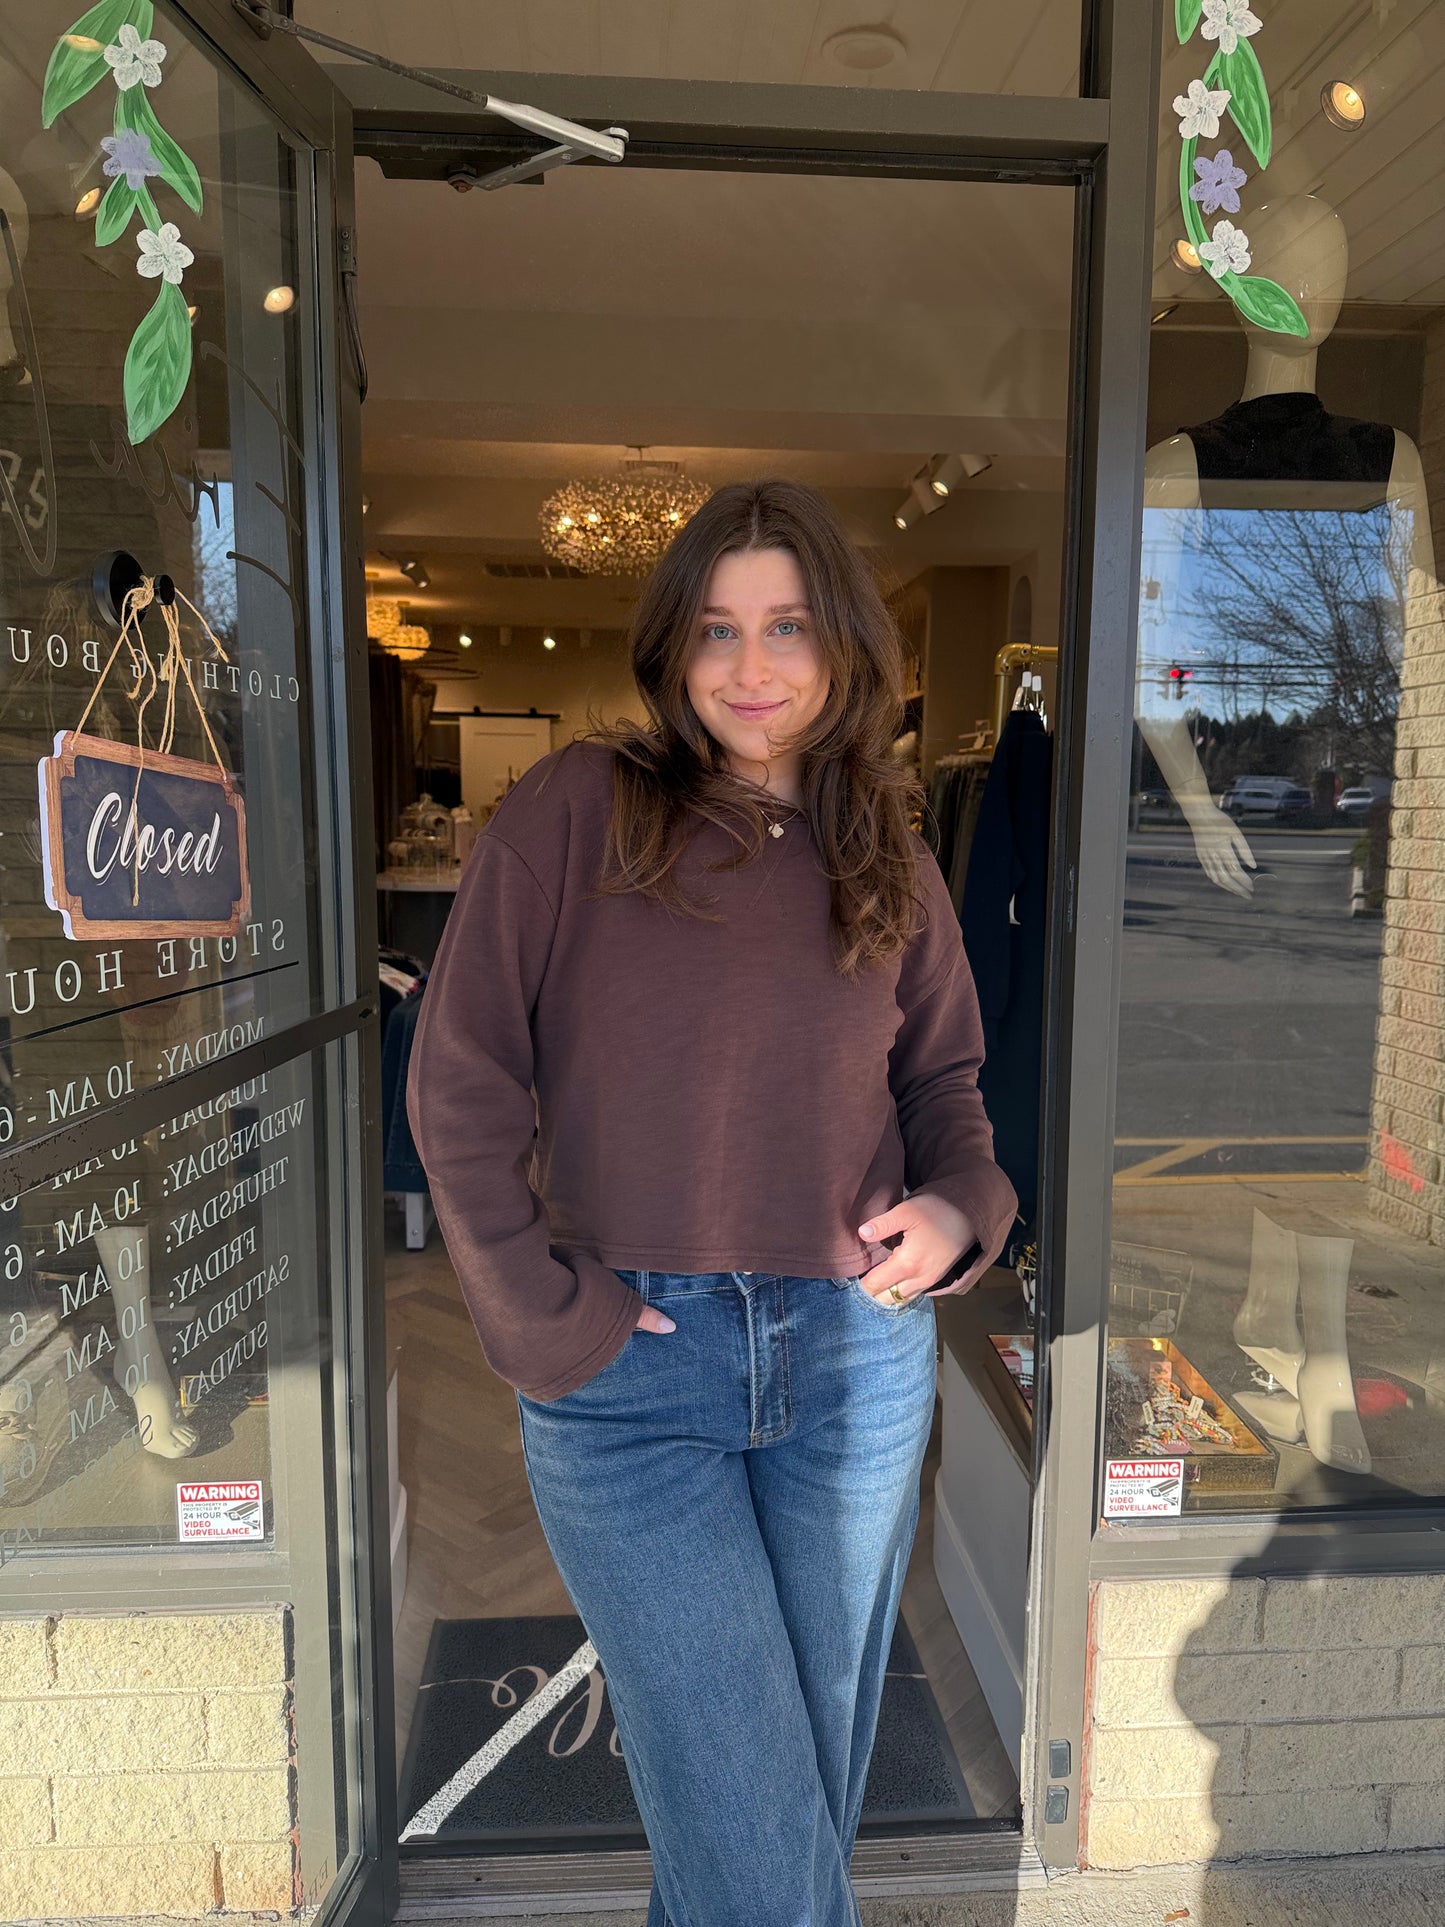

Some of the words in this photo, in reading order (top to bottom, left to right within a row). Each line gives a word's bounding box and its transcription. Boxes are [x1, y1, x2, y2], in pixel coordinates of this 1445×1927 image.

[86, 792, 224, 883] Closed
[1110, 1463, 1180, 1477] WARNING
[181, 1486, 258, 1500] WARNING
[1109, 1503, 1168, 1512] SURVEILLANCE
[183, 1512, 194, 1520] 24
[196, 1511, 222, 1519] HOUR
[183, 1520, 211, 1528] VIDEO
[184, 1527, 250, 1536] SURVEILLANCE
